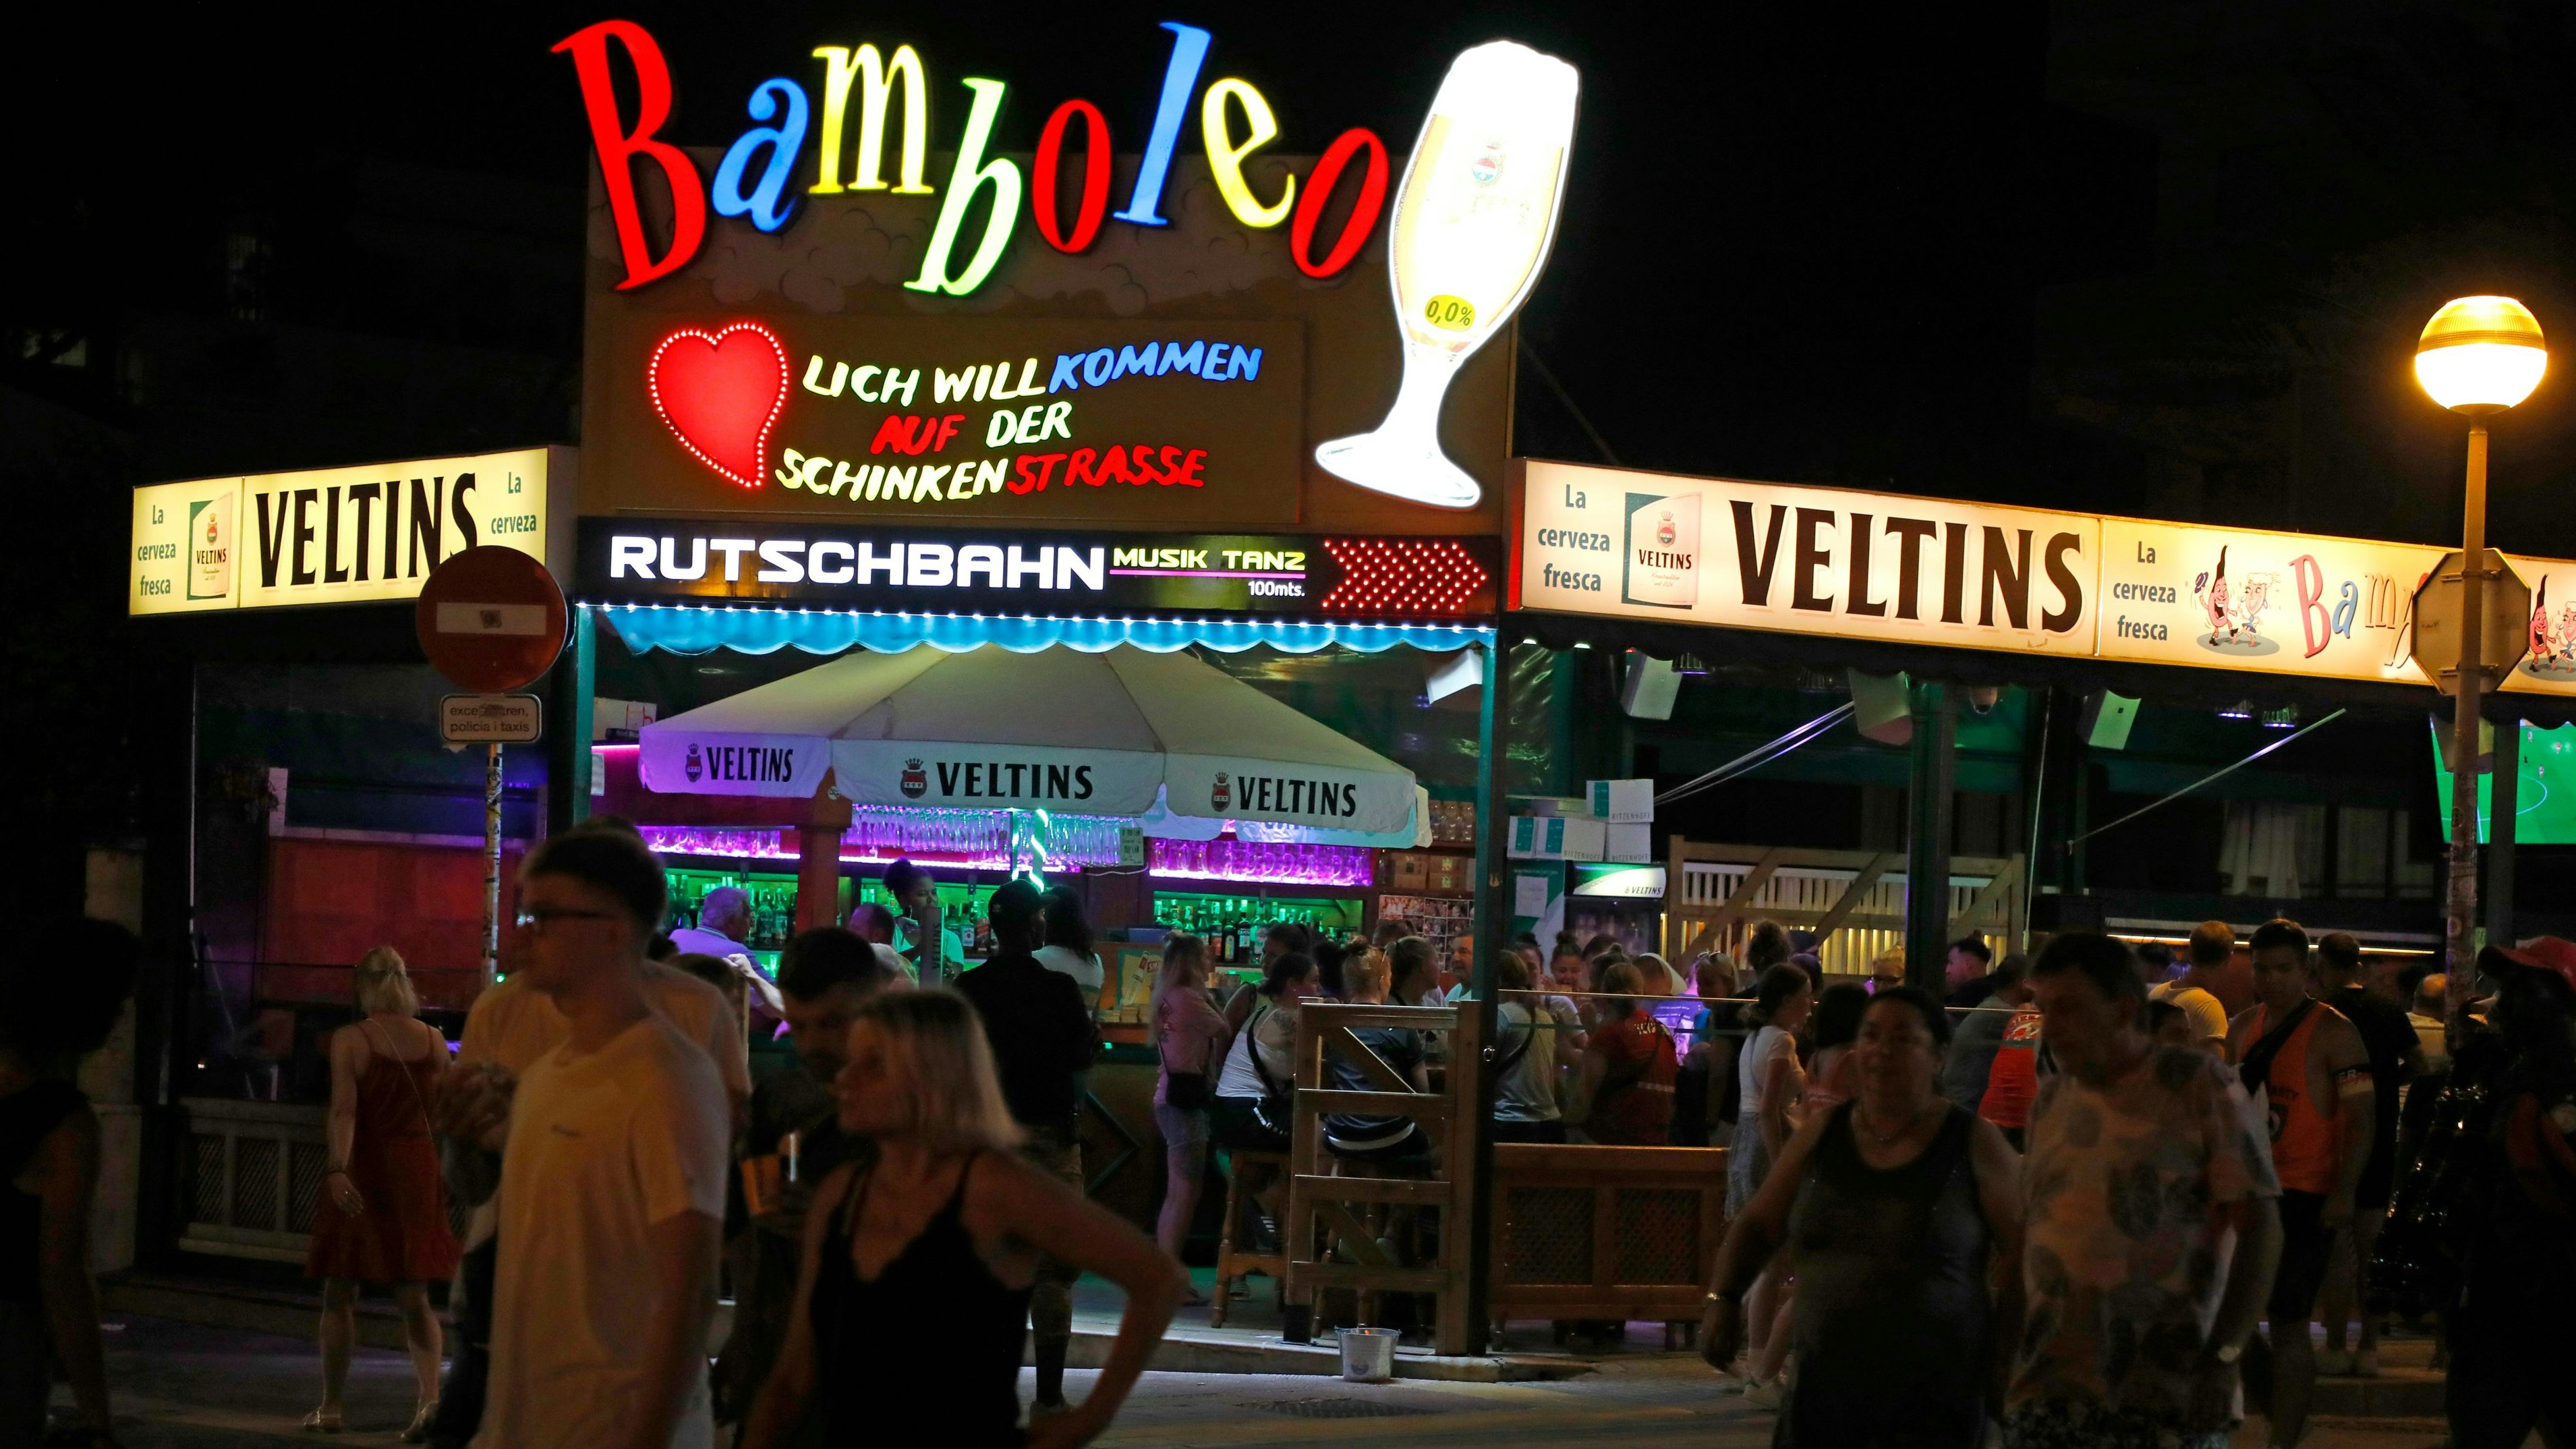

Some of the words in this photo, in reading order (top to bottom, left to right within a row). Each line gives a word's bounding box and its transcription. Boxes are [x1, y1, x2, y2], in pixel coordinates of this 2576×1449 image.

[549, 19, 1390, 296] Bamboleo
[1427, 300, 1472, 326] 0,0%
[870, 414, 966, 455] AUF
[985, 401, 1073, 450] DER
[508, 472, 521, 494] La
[1564, 484, 1587, 509] La
[152, 504, 164, 525] La
[490, 513, 537, 534] cerveza
[255, 472, 478, 588] VELTINS
[1537, 526, 1611, 552] cerveza
[137, 540, 177, 561] cerveza
[196, 548, 227, 565] VELTINS
[1112, 547, 1208, 569] MUSIK
[1222, 550, 1306, 571] TANZ
[1638, 548, 1692, 570] VELTINS
[2137, 540, 2156, 564] La
[610, 535, 1105, 591] RUTSCHBAHN
[1728, 499, 2082, 633] VELTINS
[140, 574, 171, 596] fresca
[1247, 580, 1305, 597] 100mts.
[1543, 563, 1602, 592] fresca
[2113, 581, 2177, 604] cerveza
[2117, 615, 2168, 641] fresca
[500, 720, 530, 732] taxis
[706, 746, 794, 783] VELTINS
[936, 762, 1093, 800] VELTINS
[1237, 775, 1357, 818] VELTINS
[1611, 812, 1651, 821] RITZENHOFF
[1563, 850, 1601, 861] RITZENHOFF
[1611, 853, 1649, 862] RITZENHOFF
[1631, 886, 1662, 896] VELTINS
